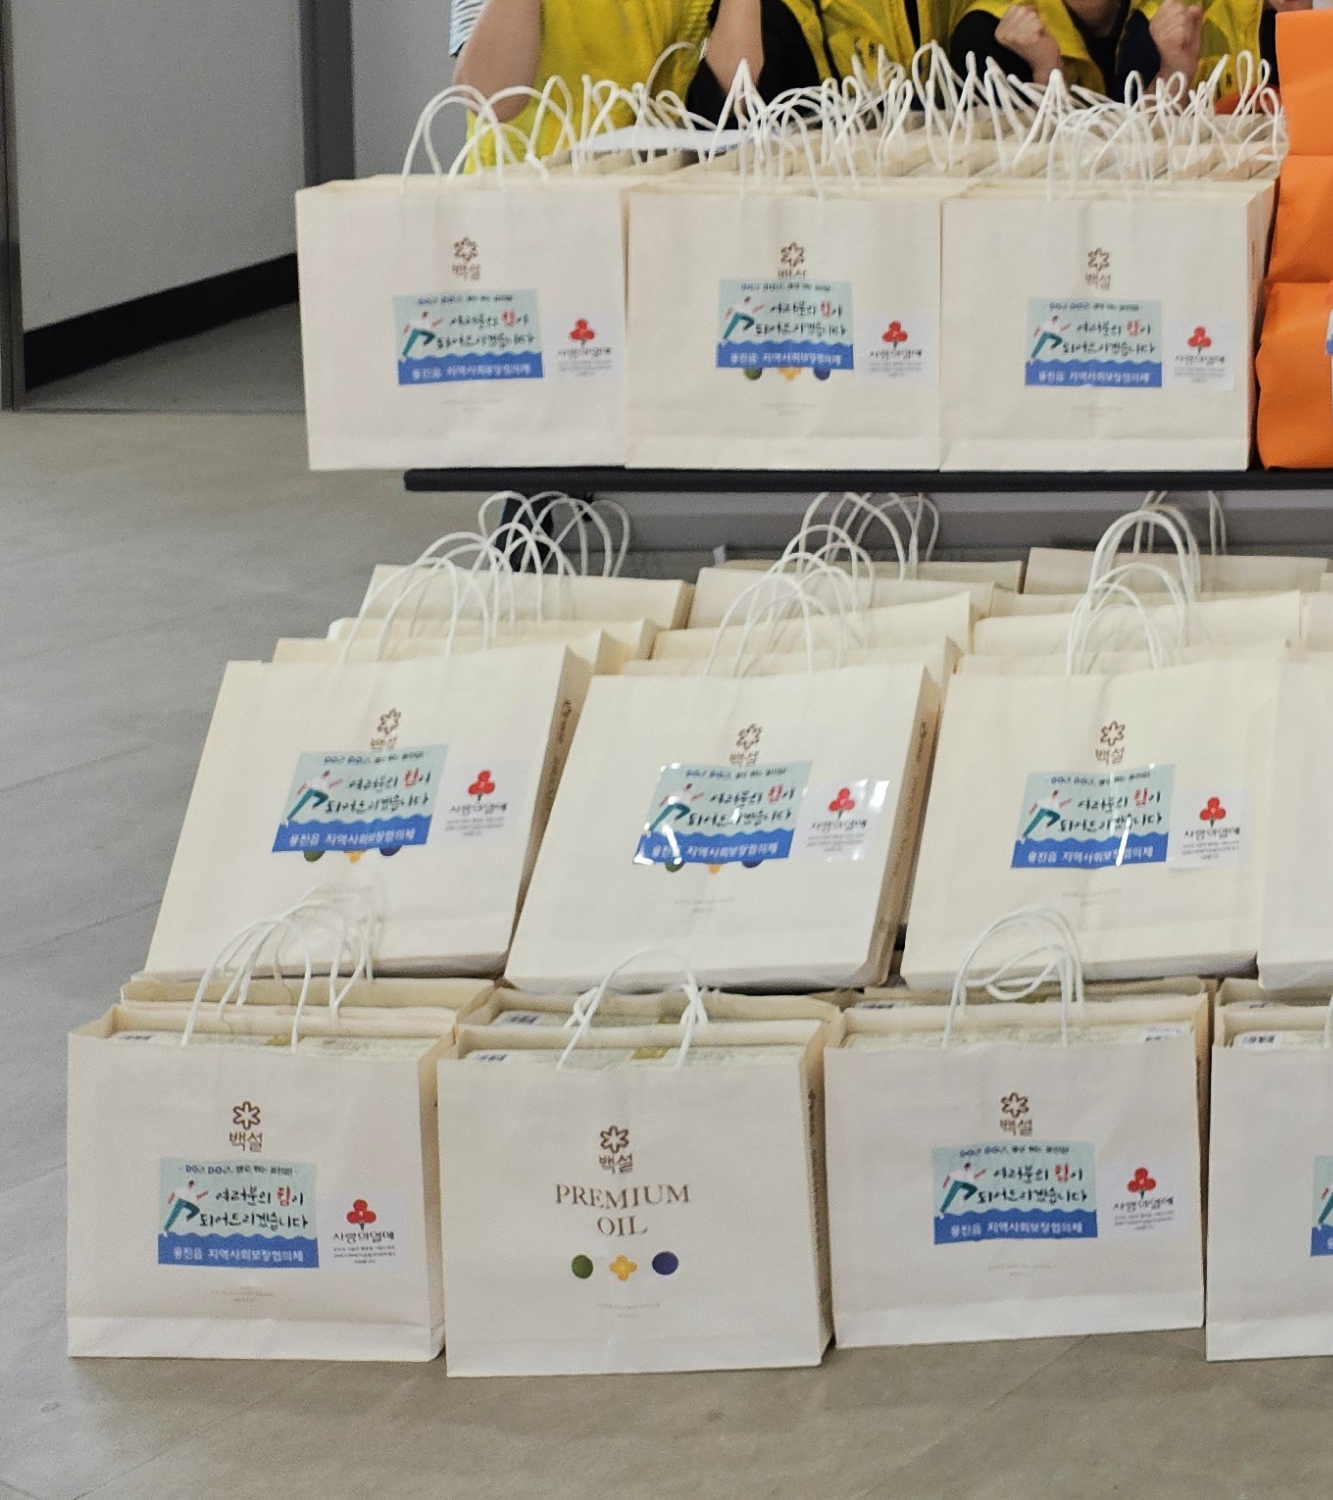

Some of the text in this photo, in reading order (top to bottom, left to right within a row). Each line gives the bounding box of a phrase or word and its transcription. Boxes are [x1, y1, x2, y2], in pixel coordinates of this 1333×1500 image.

[1095, 745, 1125, 764] 백설
[1000, 1116, 1033, 1137] 백설
[230, 1131, 263, 1152] 백설
[599, 1153, 633, 1174] 백설
[554, 1183, 691, 1210] PREMIUM
[597, 1215, 648, 1237] OIL
